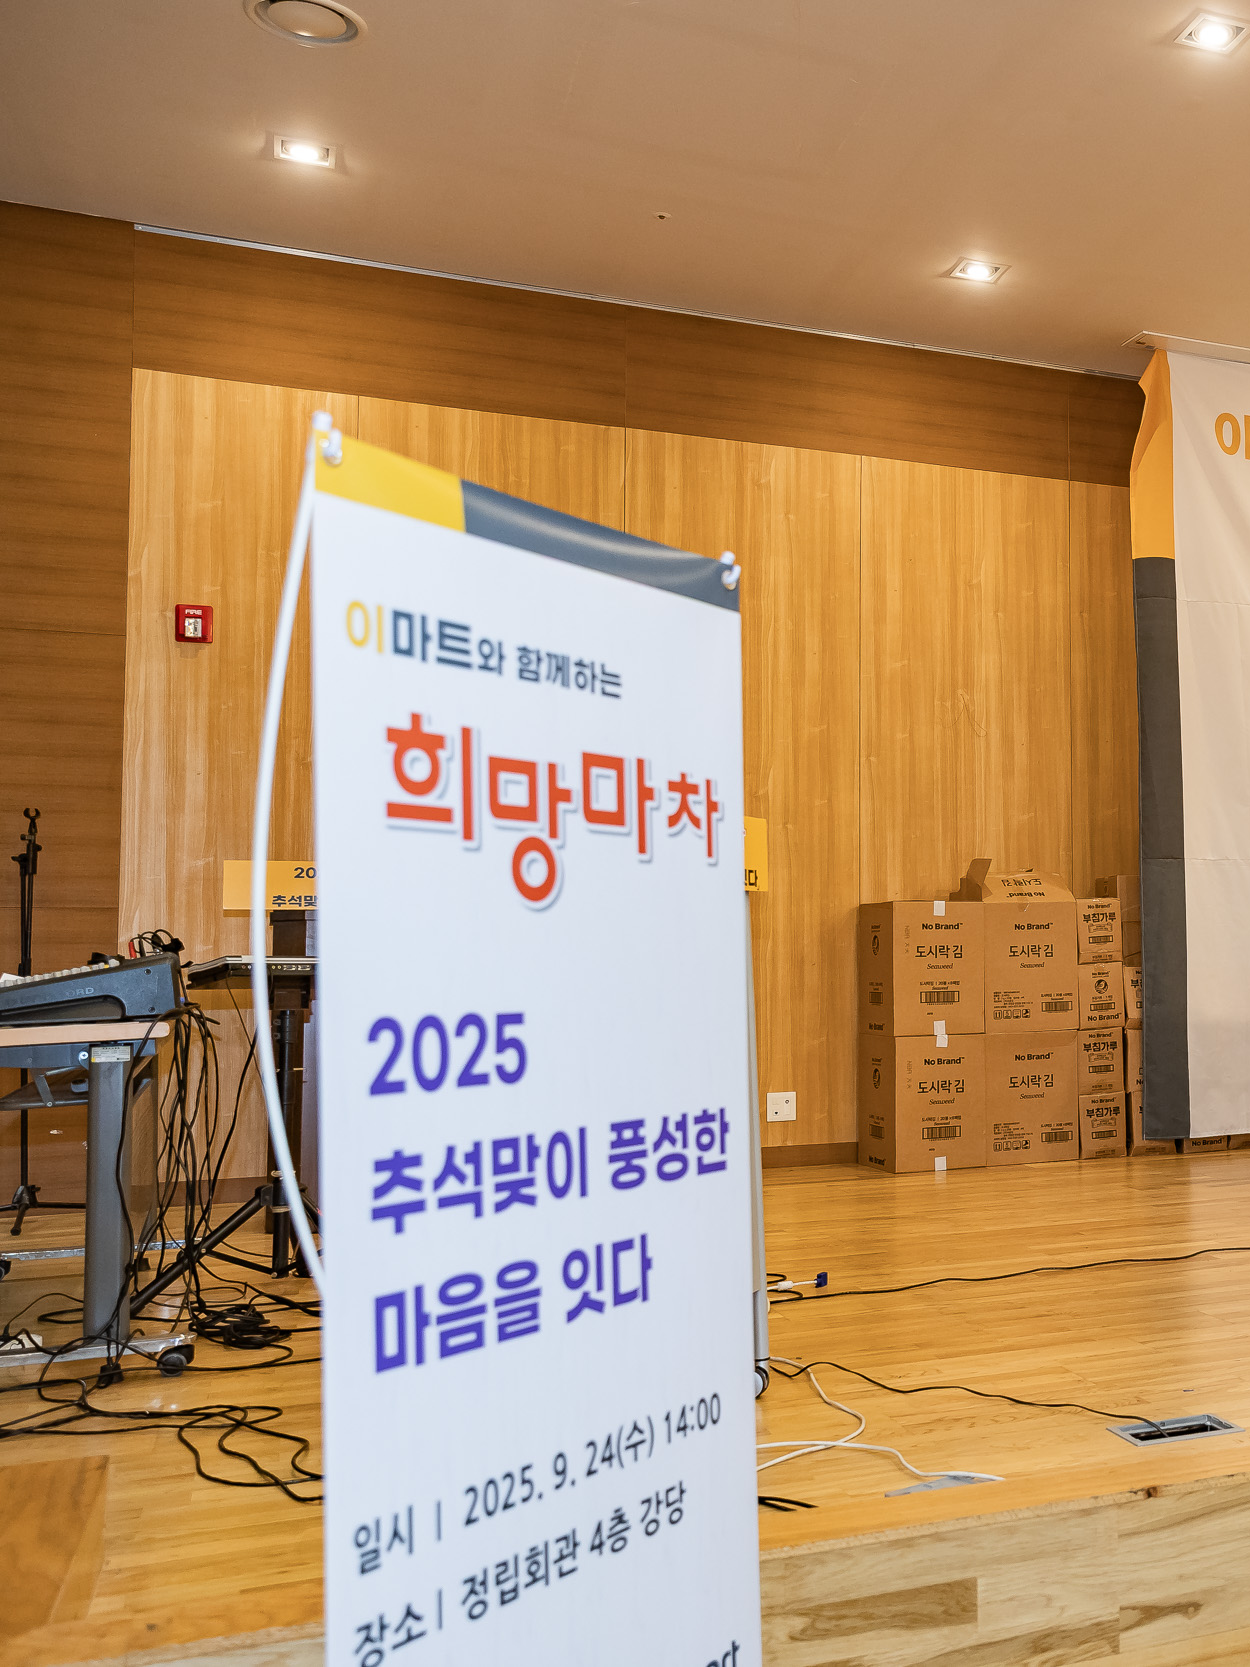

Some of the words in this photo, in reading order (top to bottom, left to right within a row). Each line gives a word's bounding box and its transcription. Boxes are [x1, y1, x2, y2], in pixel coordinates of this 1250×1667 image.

[346, 599, 506, 676] 이마트와
[516, 645, 622, 700] 함께하는
[386, 712, 719, 903] 희망마차
[294, 867, 317, 878] 20
[272, 895, 318, 907] 추석맞
[1083, 912, 1116, 924] 부침가루
[935, 922, 960, 930] Brand
[915, 945, 950, 958] 도시락
[1009, 945, 1041, 957] 도시락
[1087, 1014, 1097, 1022] No
[1099, 1013, 1119, 1021] Brand
[1083, 1041, 1117, 1052] 부침가루
[367, 1012, 528, 1096] 2025
[1027, 1052, 1050, 1060] Brand
[937, 1057, 961, 1065] Brand
[917, 1080, 952, 1093] 도시락
[1009, 1075, 1041, 1088] 도시락
[1086, 1106, 1120, 1118] 부침가루
[371, 1126, 589, 1235] 추석맞이
[607, 1108, 730, 1190] 풍성한
[374, 1259, 542, 1374] 마음을
[561, 1233, 653, 1324] 잇다
[353, 1504, 415, 1576] 일시
[463, 1463, 544, 1527] 2025.
[584, 1415, 656, 1478] 24(수)
[664, 1392, 722, 1444] 14:00
[353, 1602, 428, 1667] 장소
[461, 1528, 582, 1621] 정립회관
[589, 1506, 632, 1557] 4층
[639, 1480, 688, 1537] 강당
